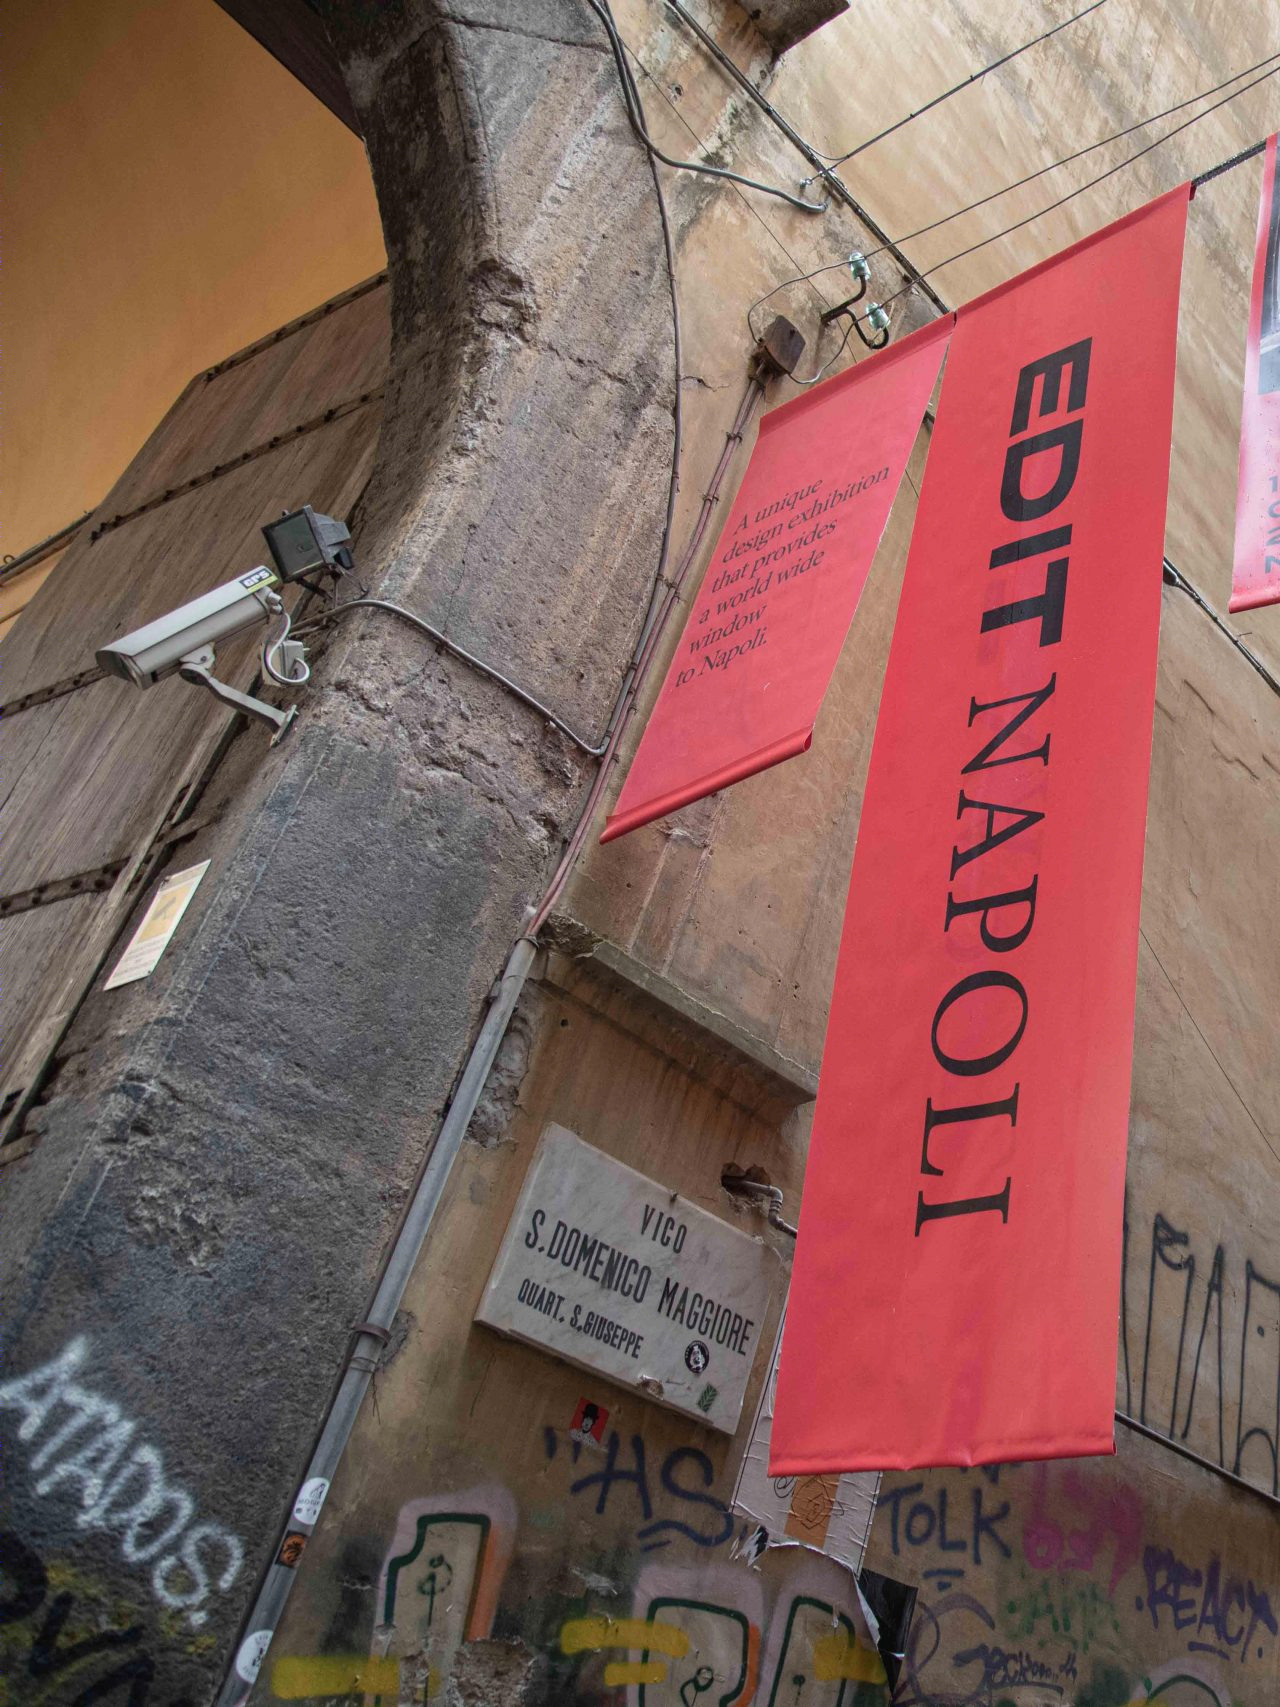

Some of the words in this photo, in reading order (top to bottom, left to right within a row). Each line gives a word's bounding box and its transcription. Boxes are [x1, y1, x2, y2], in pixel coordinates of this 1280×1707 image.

[721, 523, 783, 564] design
[787, 466, 890, 531] exhibition
[732, 513, 749, 537] A
[754, 479, 824, 523] unique
[981, 336, 1093, 650] EDIT
[698, 609, 710, 625] a
[715, 571, 774, 616] world
[776, 550, 826, 586] wide
[710, 562, 750, 594] that
[749, 518, 838, 580] provides
[675, 667, 696, 689] to
[697, 626, 768, 677] Napoli.
[689, 604, 768, 655] window
[914, 671, 1059, 1238] NAPOLI
[640, 1203, 688, 1255] VICO
[517, 1278, 566, 1324] QUART.
[569, 1303, 645, 1360] S.GIUSEPPE
[524, 1208, 652, 1304] S.DOMENICO
[656, 1276, 756, 1357] MAGGIORE
